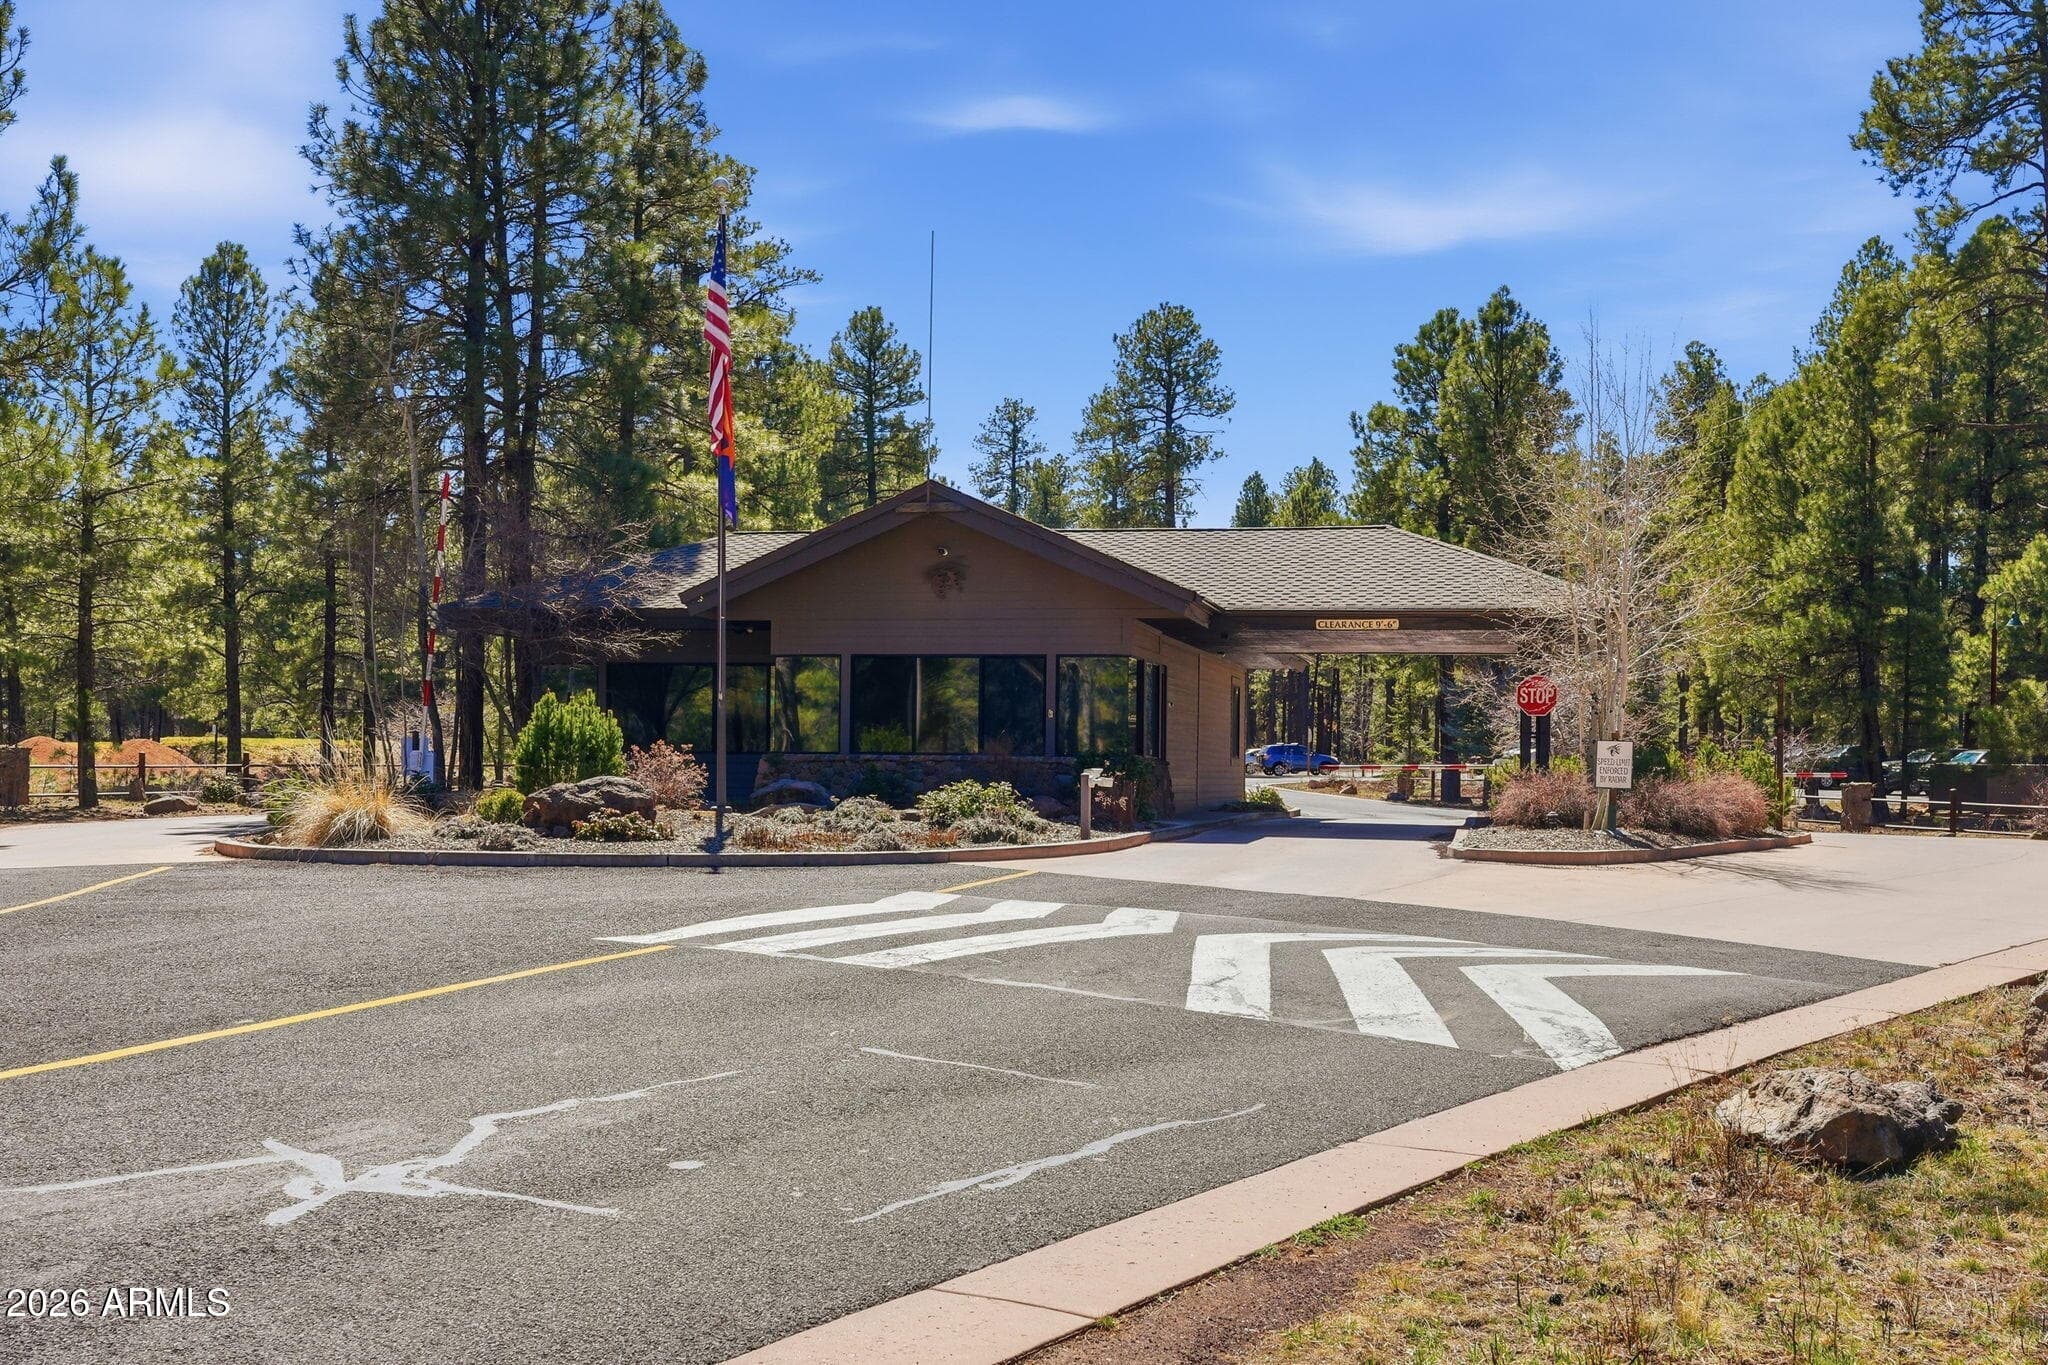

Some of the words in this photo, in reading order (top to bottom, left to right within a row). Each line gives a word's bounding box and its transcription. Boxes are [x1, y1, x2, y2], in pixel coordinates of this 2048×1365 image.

[1317, 620, 1373, 629] CLEARANCE
[1519, 687, 1555, 704] STOP
[1597, 758, 1615, 766] SPEED
[1599, 766, 1628, 775] ENFORCED
[1608, 775, 1627, 783] RADAR
